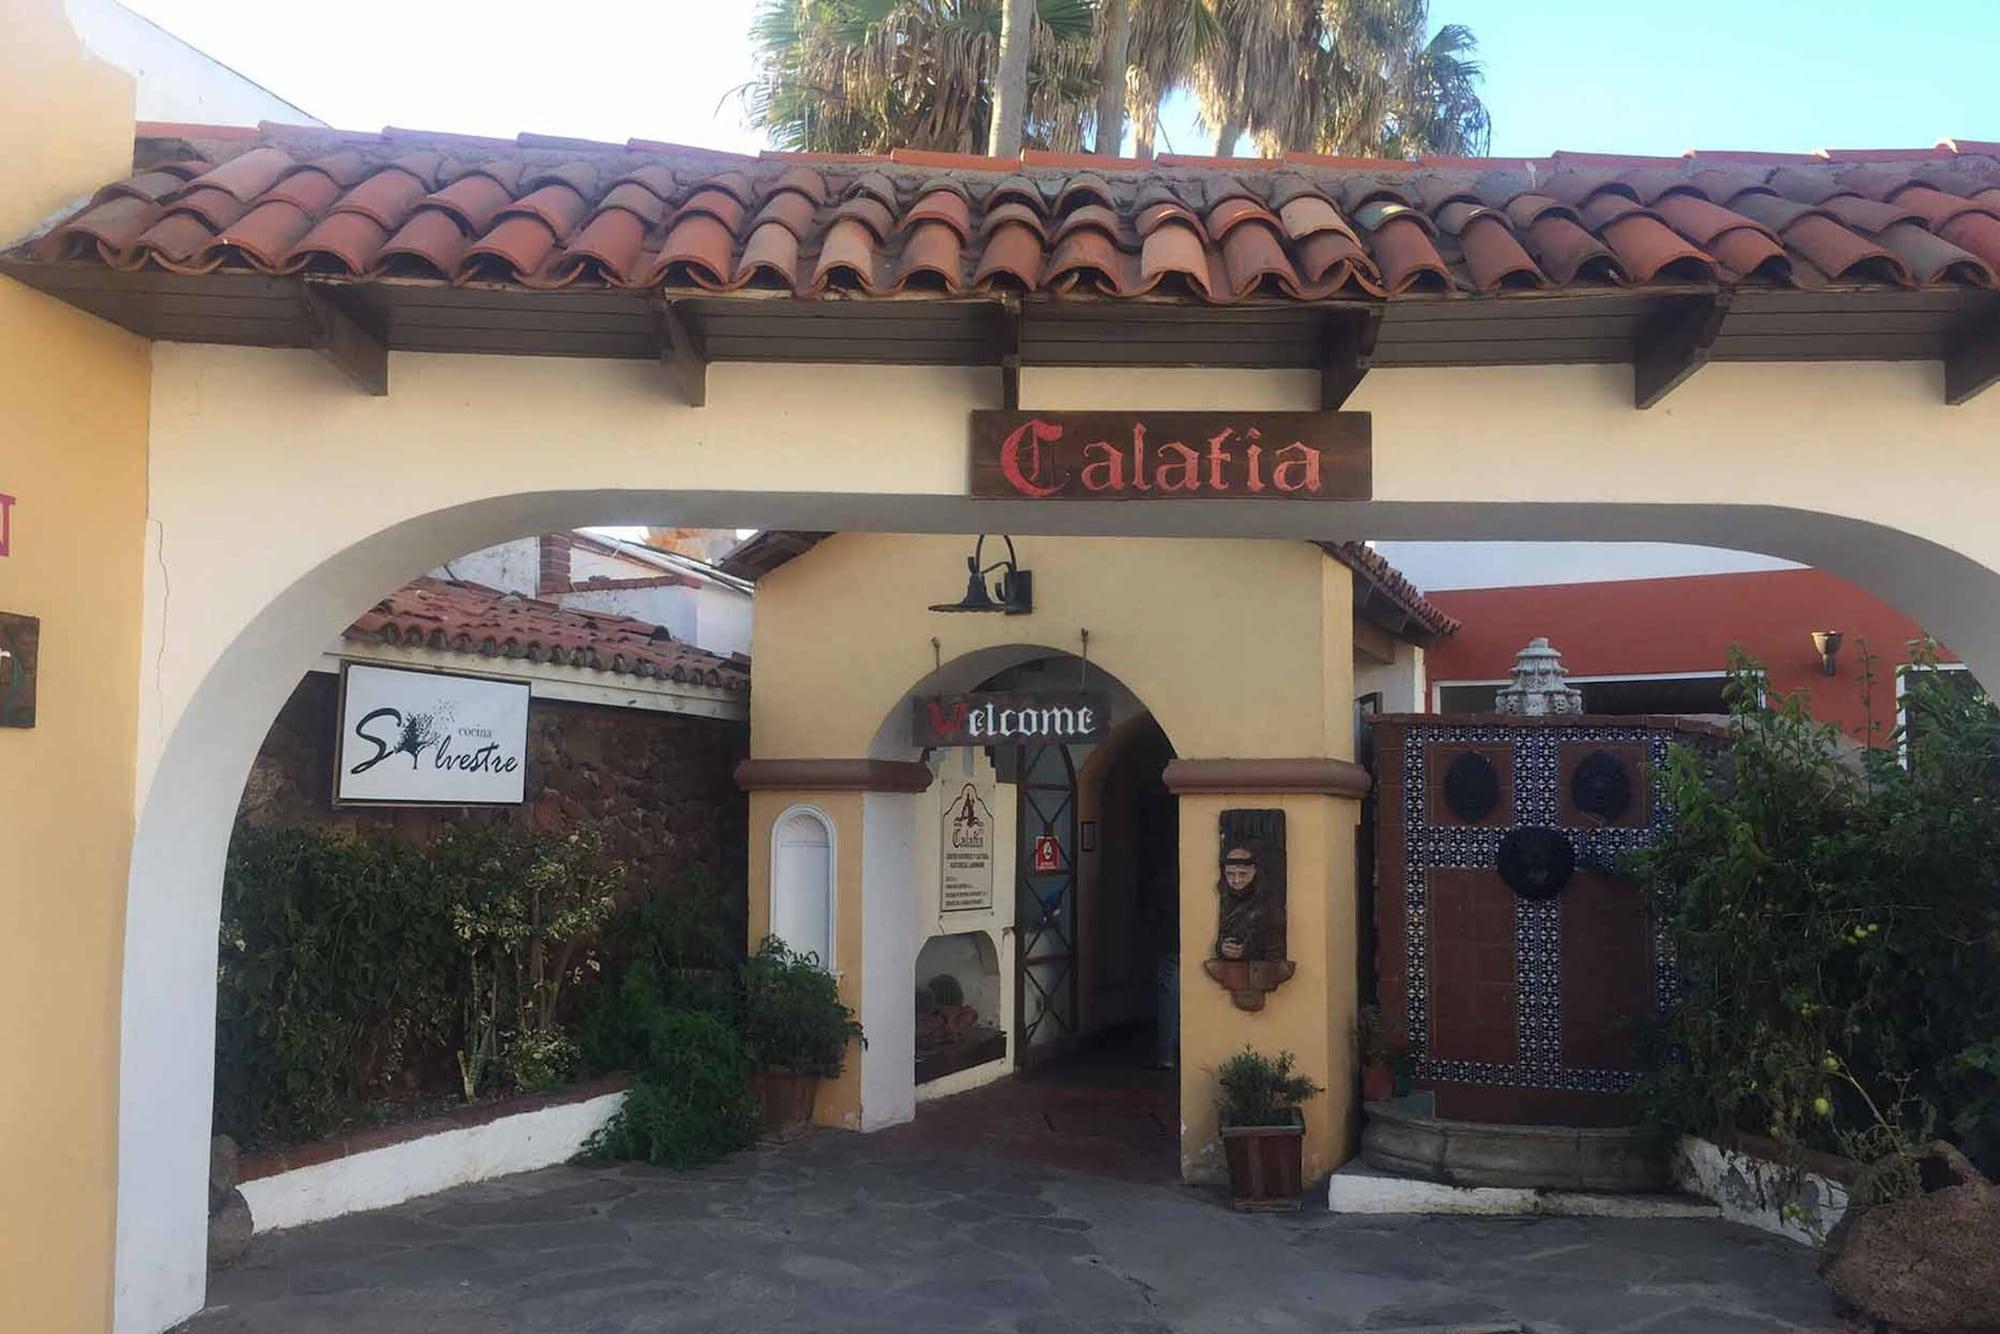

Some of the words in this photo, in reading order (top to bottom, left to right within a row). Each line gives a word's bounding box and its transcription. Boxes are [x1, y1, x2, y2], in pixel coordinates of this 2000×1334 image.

[1001, 418, 1322, 497] Calafia
[457, 722, 494, 740] cocina
[927, 701, 1097, 738] Welcome
